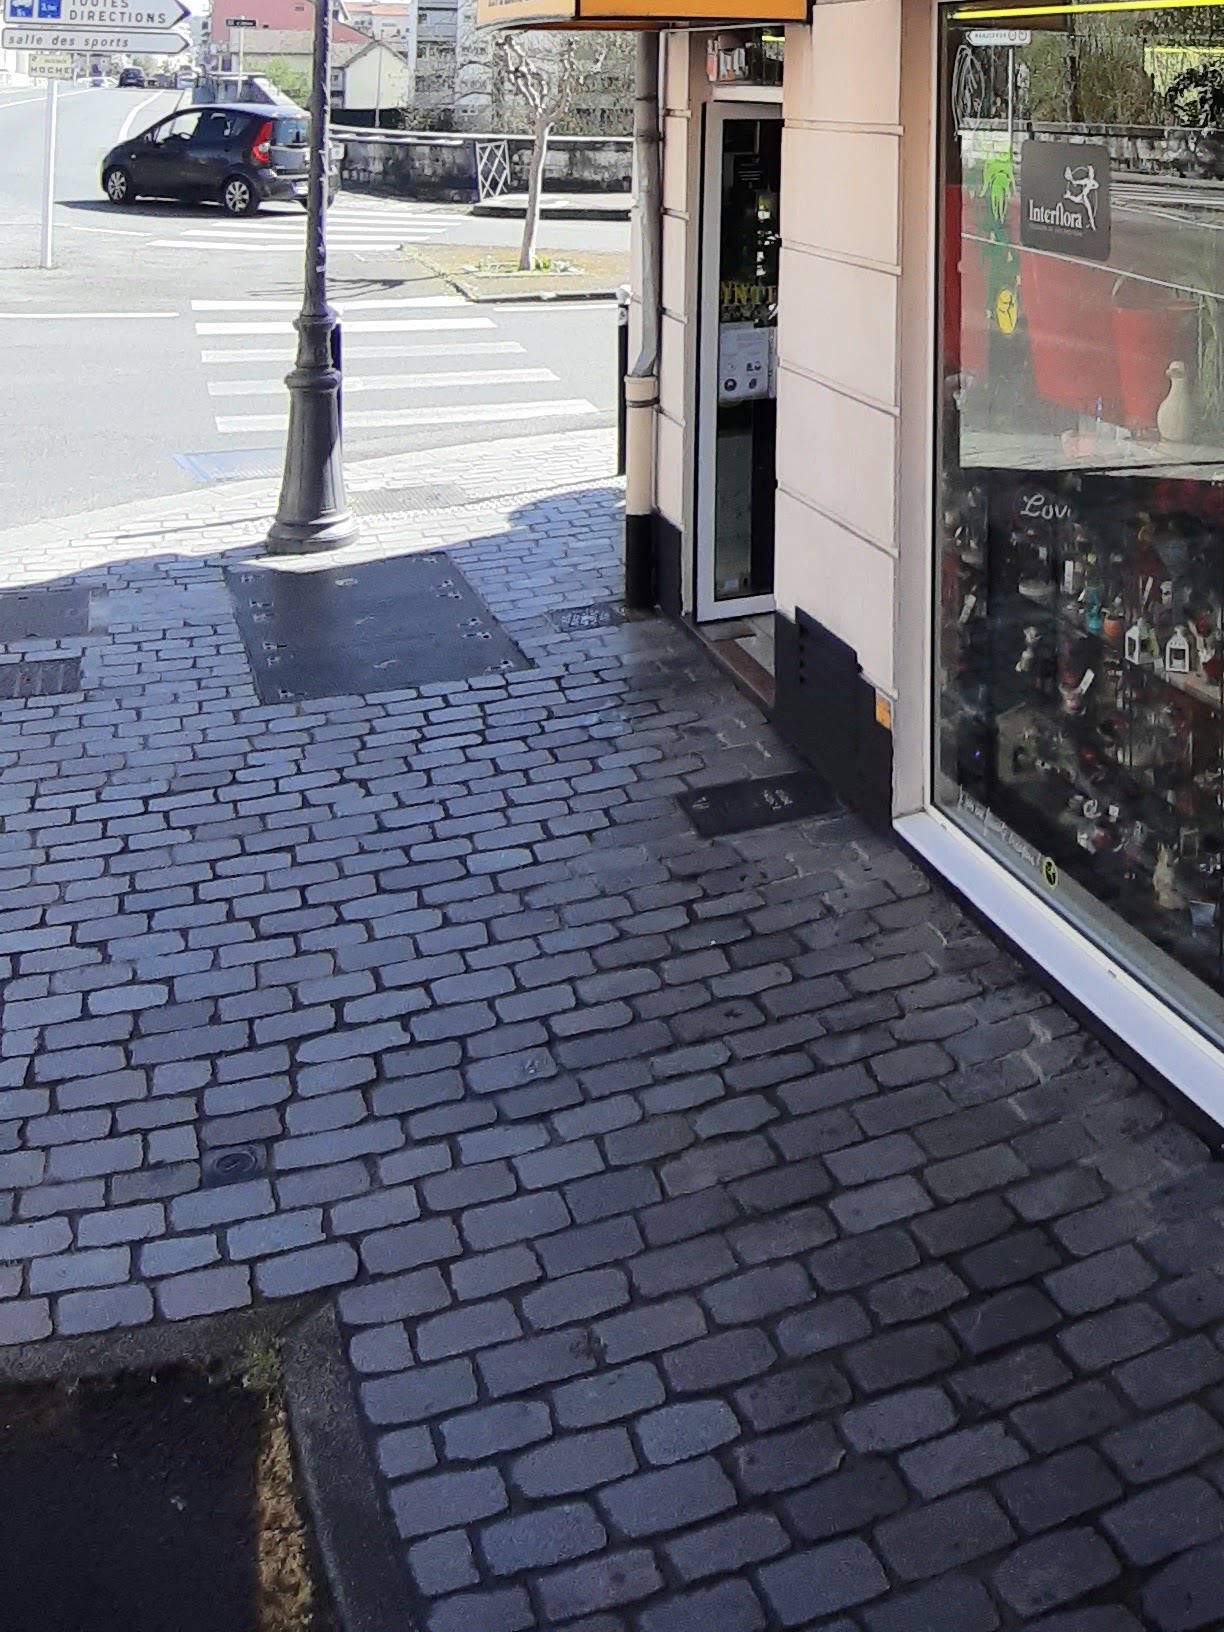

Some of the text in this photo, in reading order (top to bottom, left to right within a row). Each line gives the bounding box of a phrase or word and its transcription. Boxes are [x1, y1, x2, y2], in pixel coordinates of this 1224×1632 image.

[69, 10, 167, 24] DIRECTIONS
[8, 33, 129, 49] salle des sports
[1029, 199, 1083, 228] Interflora
[1020, 493, 1071, 520] Lov
